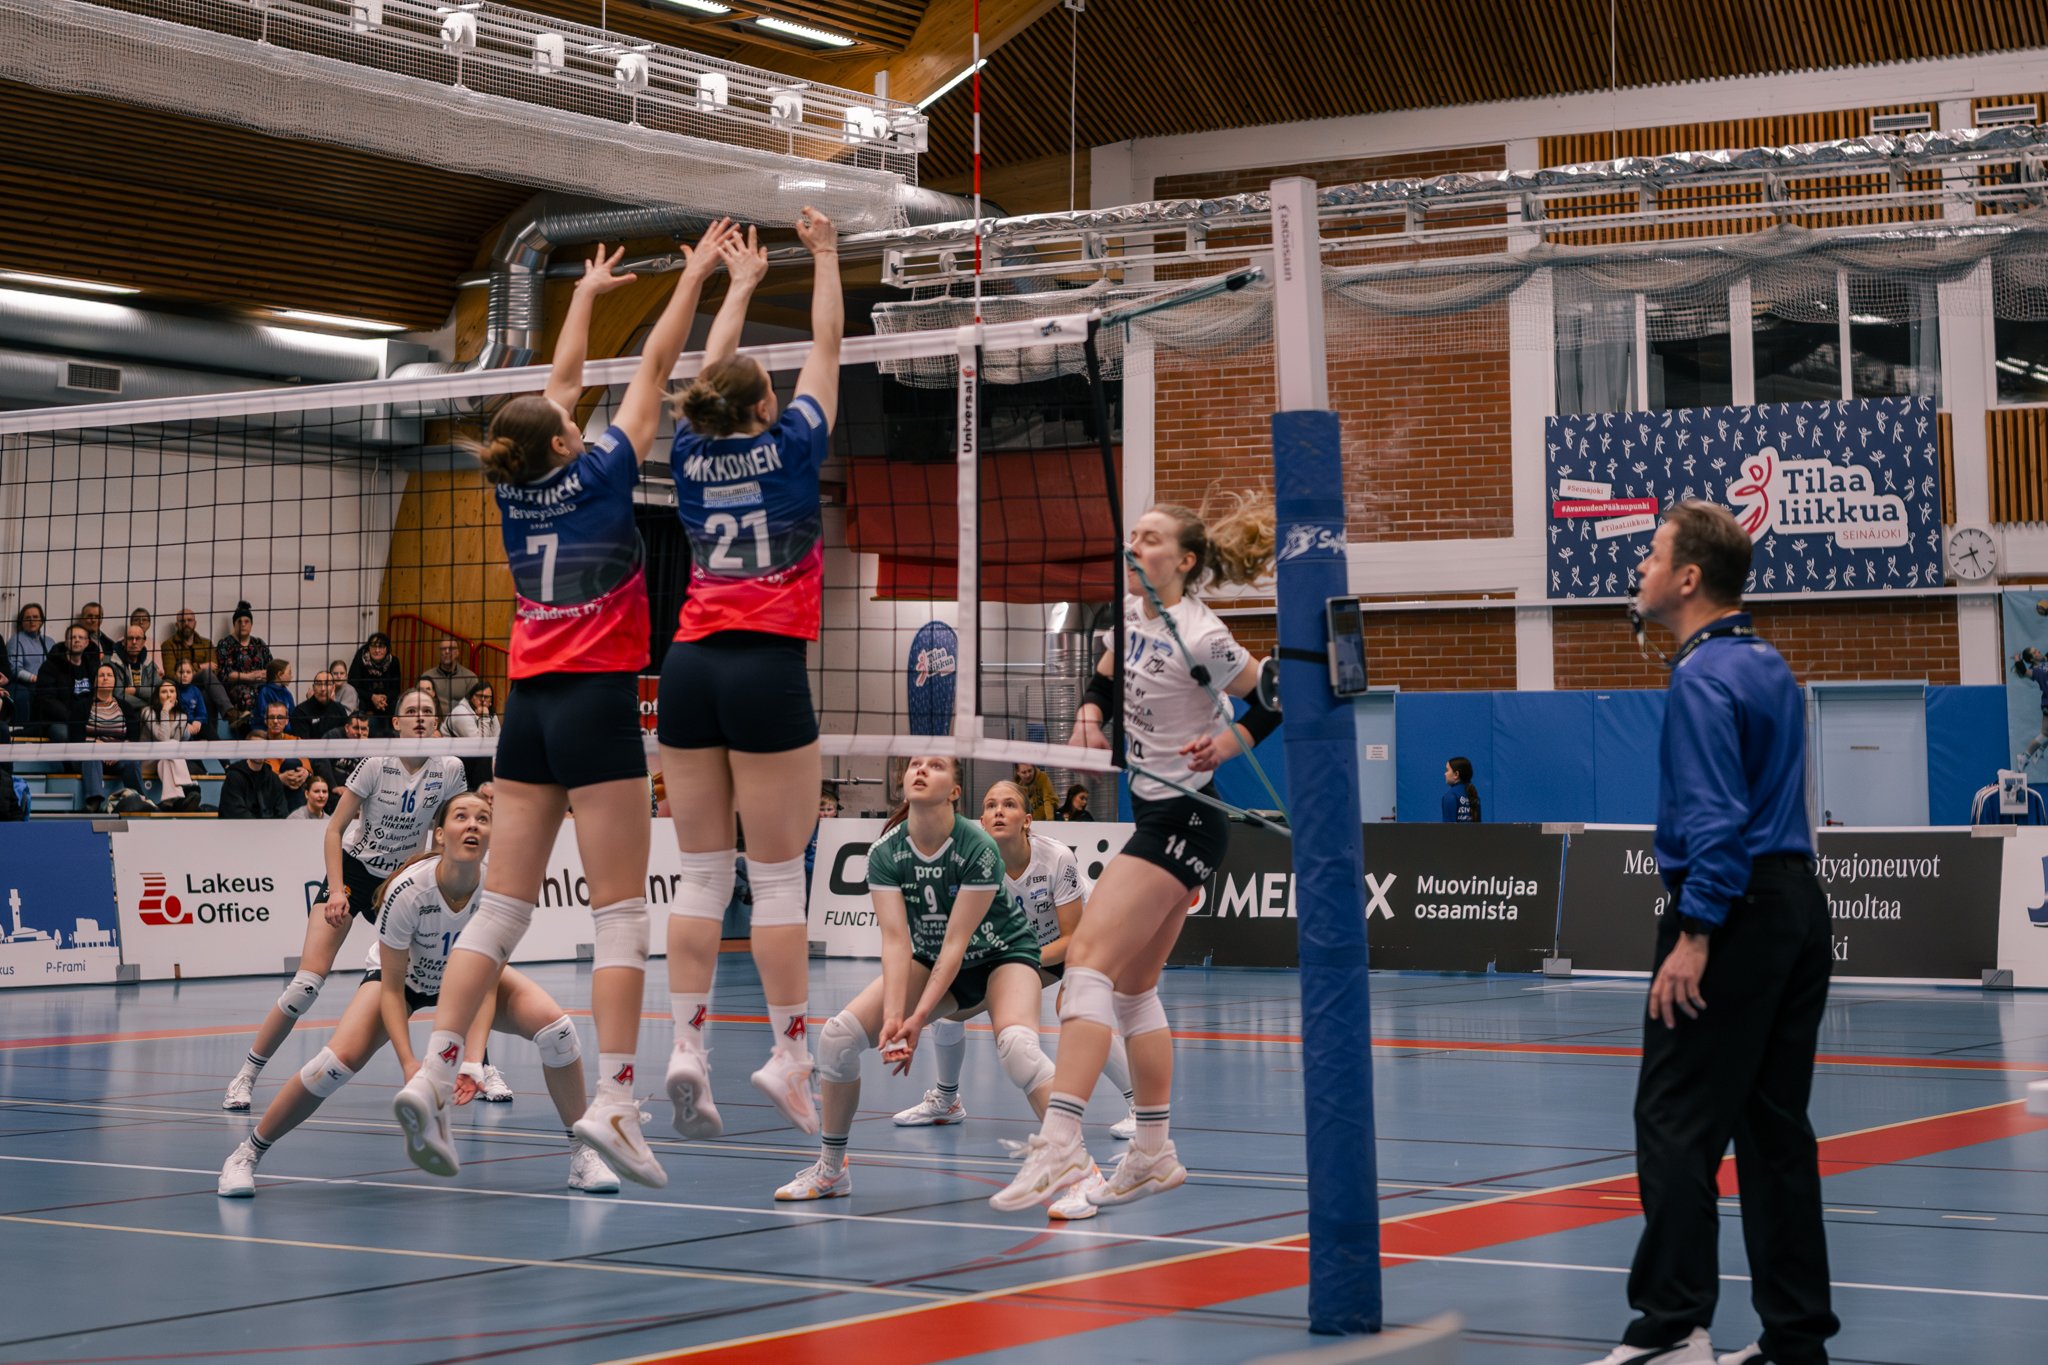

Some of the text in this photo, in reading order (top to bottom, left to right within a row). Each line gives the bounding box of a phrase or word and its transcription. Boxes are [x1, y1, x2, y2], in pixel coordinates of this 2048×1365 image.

[963, 380, 973, 453] Universal
[1782, 467, 1867, 495] Tilaa
[1561, 502, 1650, 513] #AvaruudenPääkaupunki
[1779, 500, 1900, 525] liikkua
[1601, 518, 1650, 533] #TilaaLiikkua
[1842, 527, 1901, 541] SEINÄJOKI
[703, 509, 772, 569] 21
[525, 533, 559, 602] 7
[401, 788, 417, 813] 16
[1165, 834, 1187, 860] 14
[186, 873, 275, 895] Lakeus
[914, 865, 944, 881] pro
[924, 884, 938, 913] 9
[1417, 875, 1538, 899] Muovinlujaa
[198, 901, 270, 924] Office
[380, 877, 415, 936] minimani
[1414, 900, 1519, 921] osaamista
[1826, 893, 1902, 919] huoltaa
[46, 959, 86, 973] P-Frami
